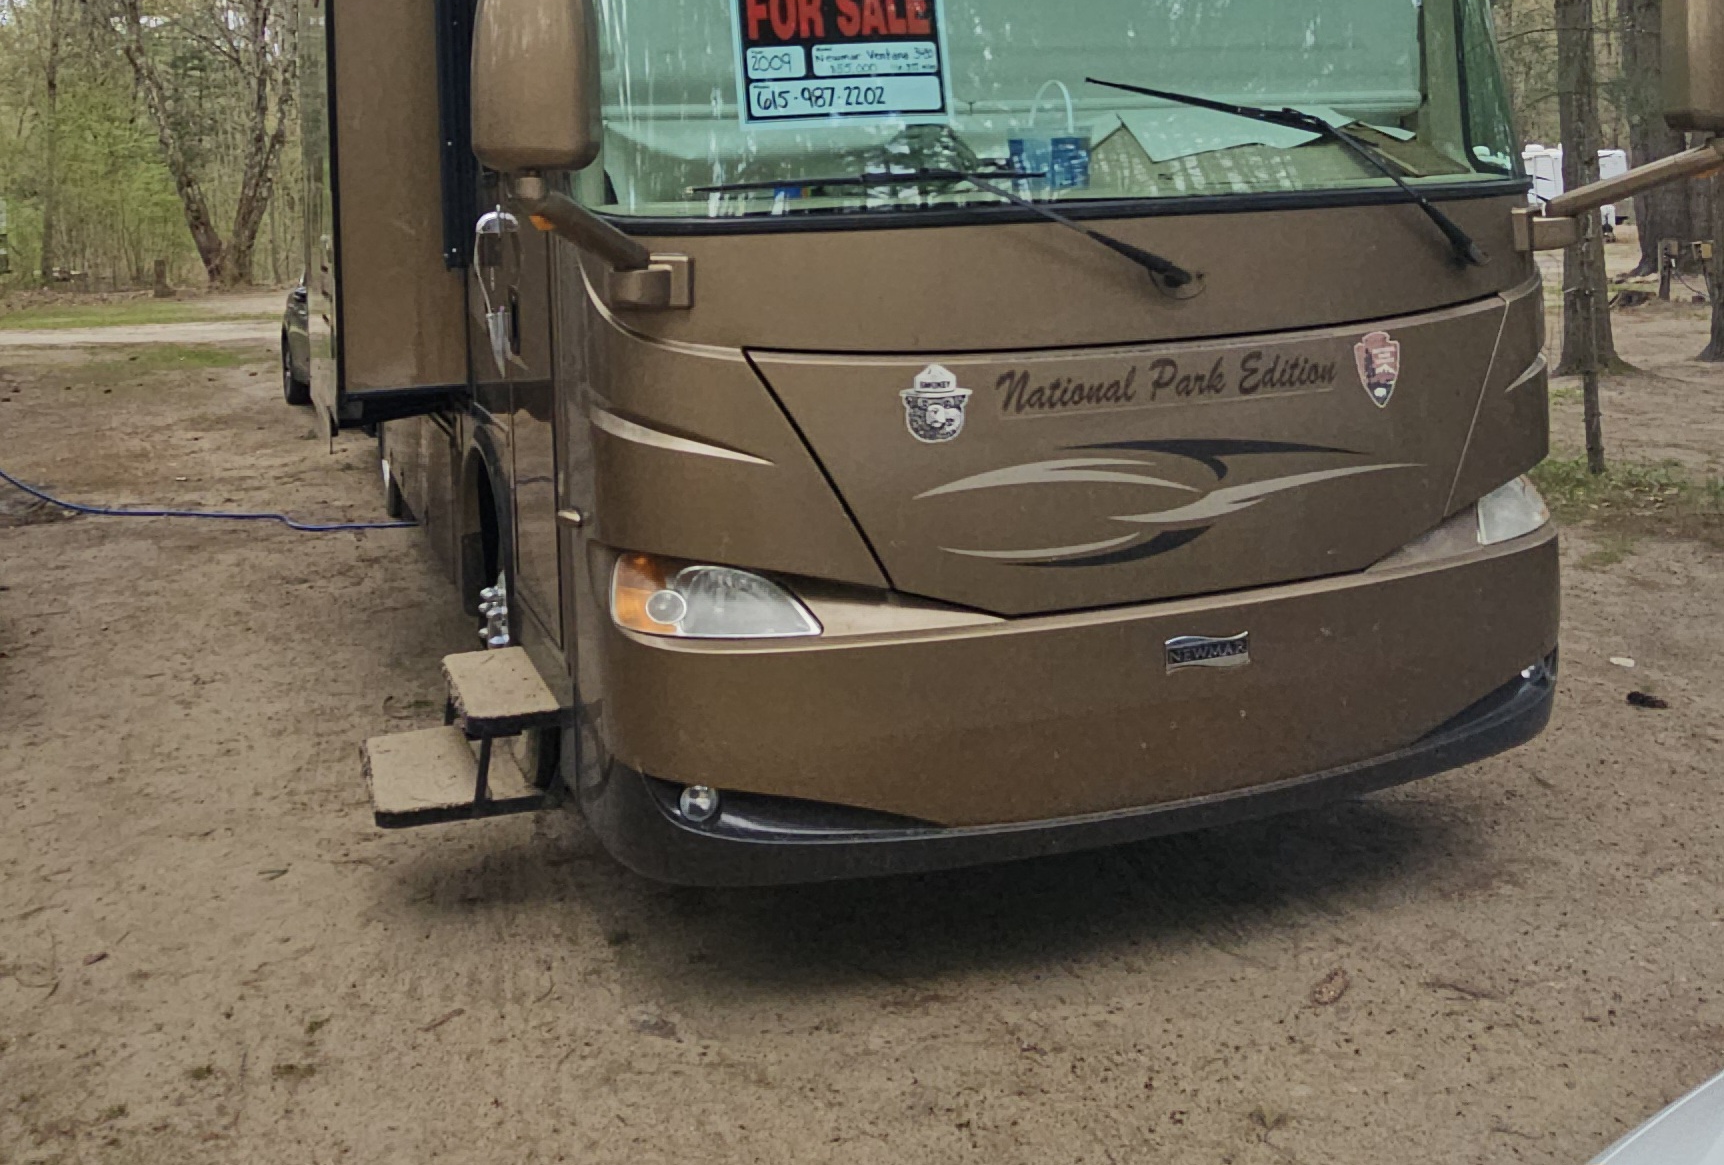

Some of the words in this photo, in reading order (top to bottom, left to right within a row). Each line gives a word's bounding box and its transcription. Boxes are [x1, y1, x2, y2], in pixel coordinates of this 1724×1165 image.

[751, 52, 792, 73] 2009
[995, 366, 1138, 413] National
[1147, 356, 1226, 400] Park
[1240, 349, 1337, 394] Edition
[1169, 640, 1247, 663] NEWMAR
